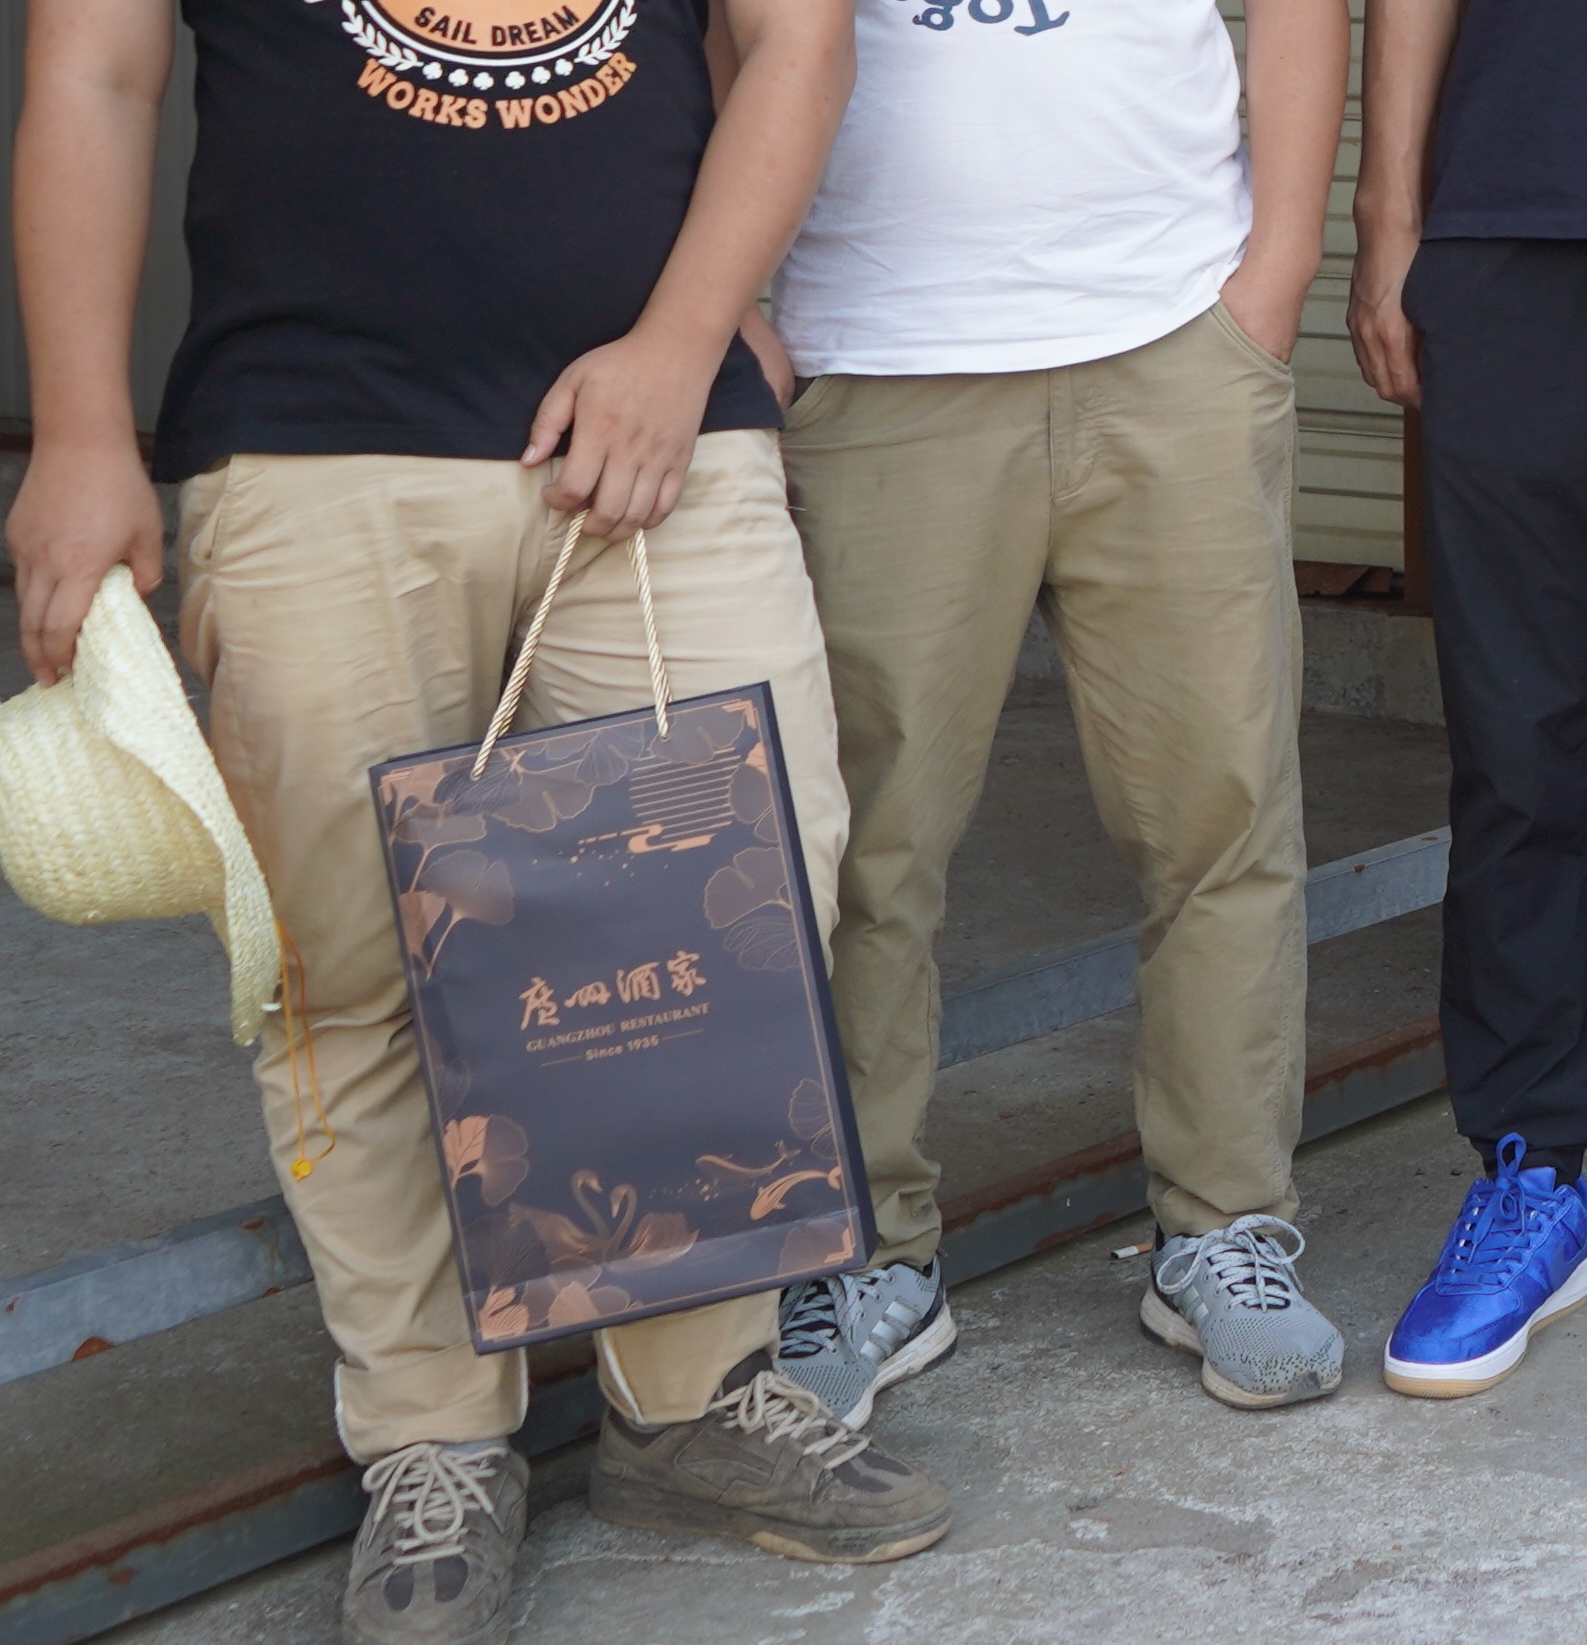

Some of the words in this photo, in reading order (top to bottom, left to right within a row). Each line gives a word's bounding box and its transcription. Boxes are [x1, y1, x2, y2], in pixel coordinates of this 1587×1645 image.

[413, 6, 477, 46] SAIL
[491, 6, 579, 47] DREAM
[356, 58, 488, 129] WORKS
[496, 52, 637, 129] WONDER
[526, 1023, 614, 1052] GUANGZHOU
[620, 1002, 709, 1032] RESTAURANT
[584, 1044, 624, 1061] Since
